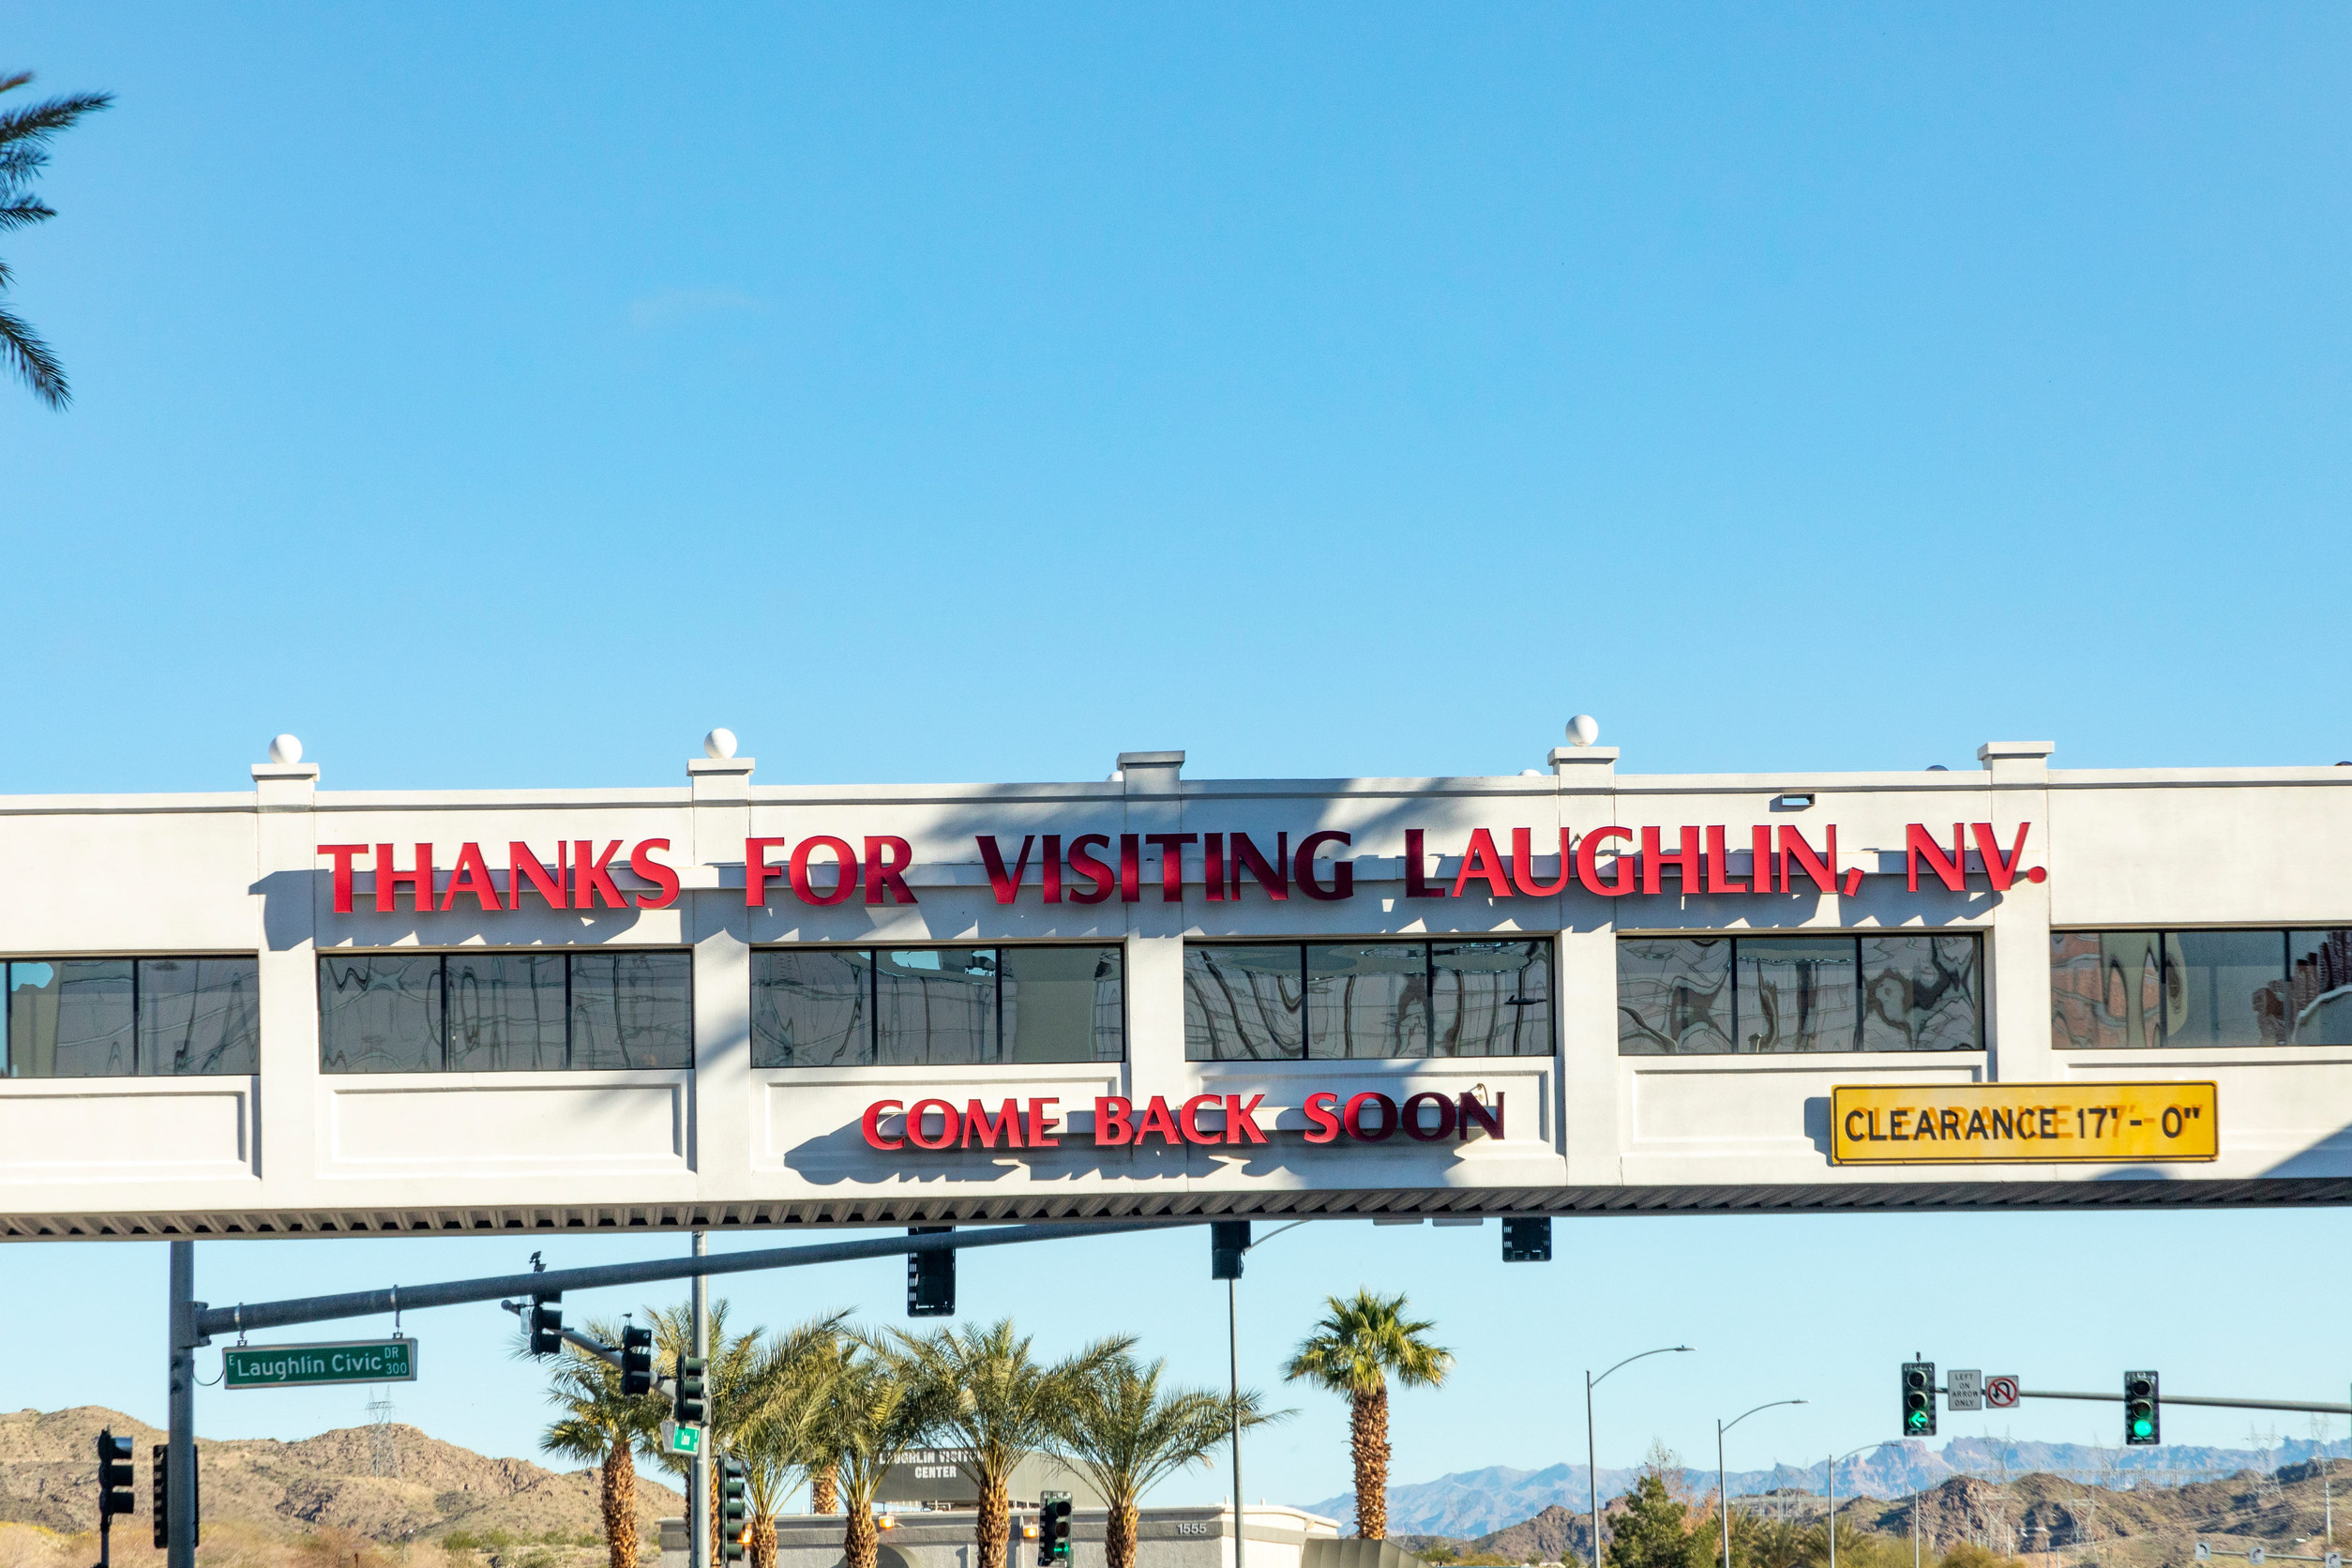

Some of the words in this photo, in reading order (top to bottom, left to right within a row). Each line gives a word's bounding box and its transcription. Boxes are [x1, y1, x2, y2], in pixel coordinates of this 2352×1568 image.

[316, 837, 681, 913] THANKS
[745, 835, 919, 907] FOR
[974, 830, 1354, 905] VISITING
[1404, 823, 1864, 898] LAUGHLIN,
[1906, 822, 2048, 892] NV.
[861, 1096, 1062, 1151] COME
[1093, 1093, 1270, 1146] BACK
[1303, 1091, 1506, 1144] SOON
[1844, 1108, 2059, 1141] CLEARANCE
[228, 1355, 235, 1366] E
[237, 1355, 325, 1380] Laughlin
[331, 1353, 383, 1373] Civic
[384, 1347, 400, 1359] DR
[384, 1362, 408, 1375] 300
[1952, 1390, 1979, 1398] ARROW
[914, 1465, 957, 1479] CENTER
[1177, 1522, 1207, 1534] 1555
